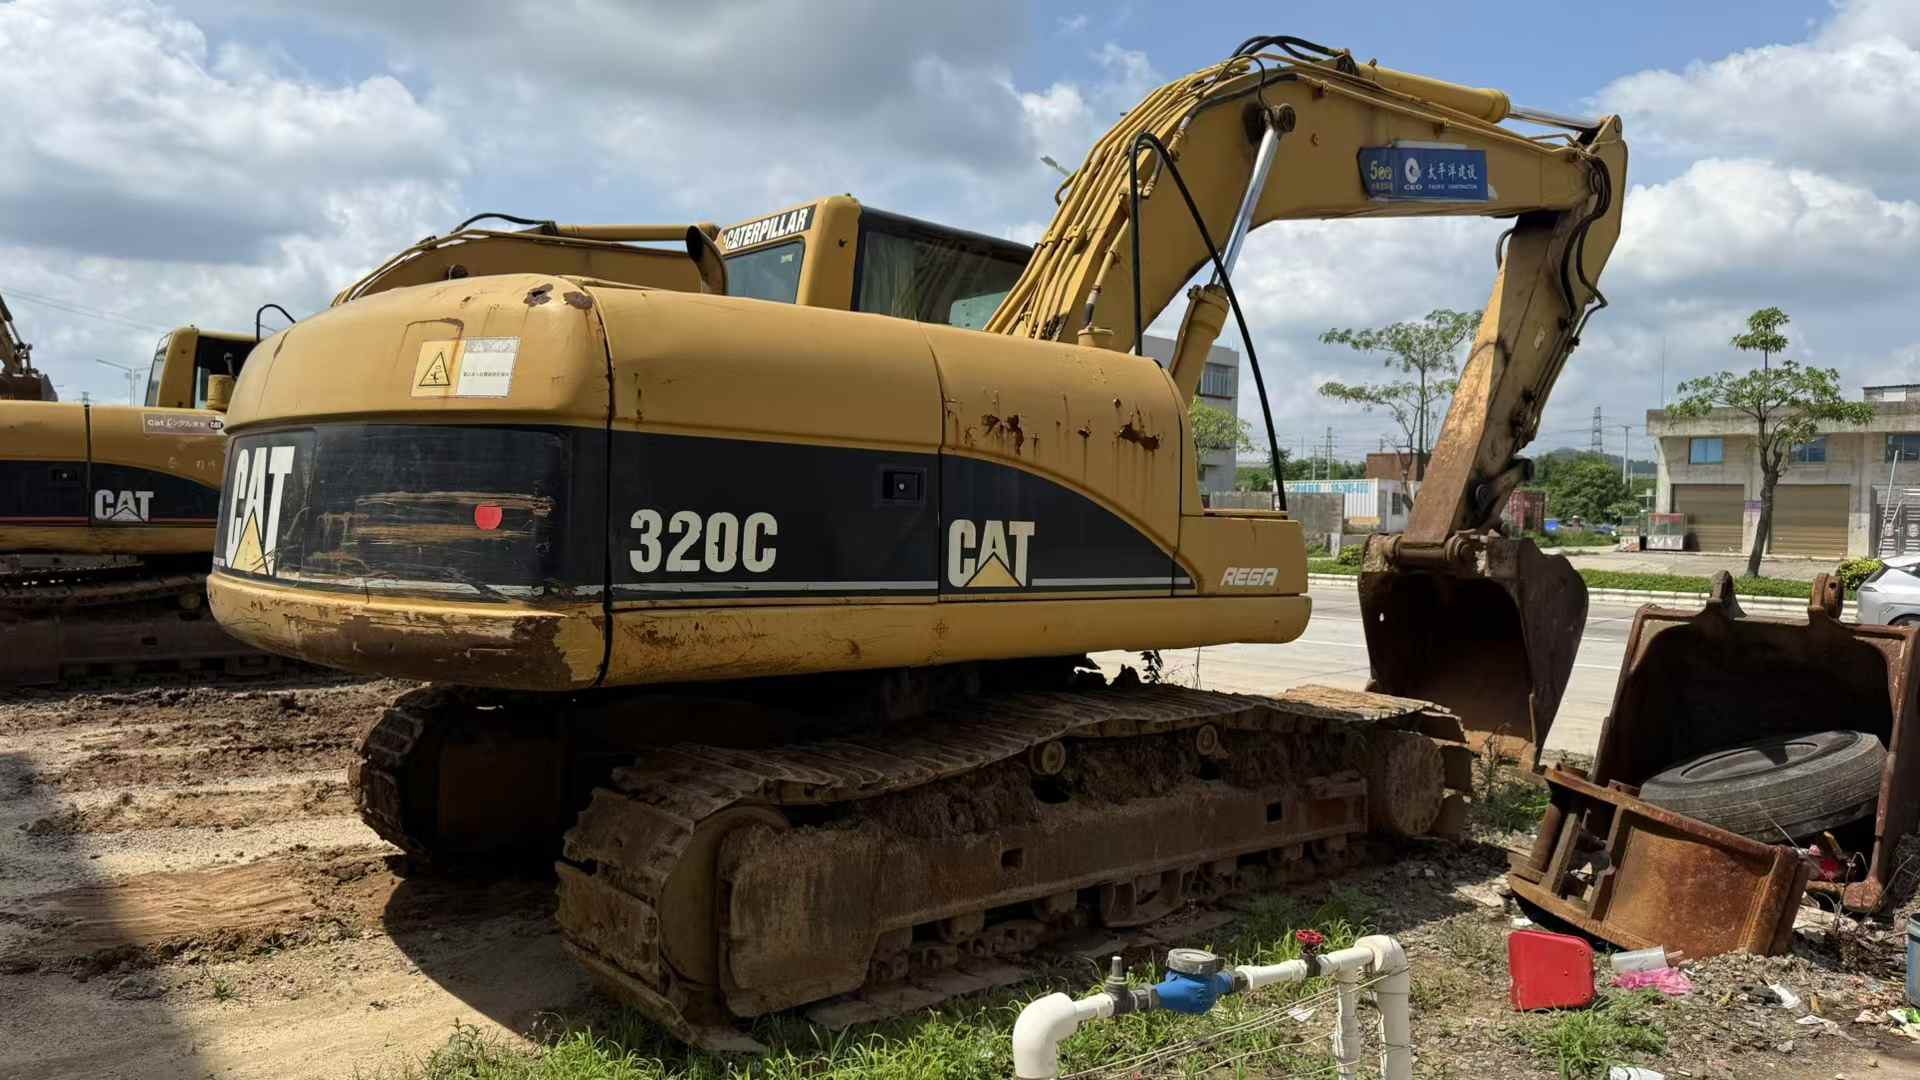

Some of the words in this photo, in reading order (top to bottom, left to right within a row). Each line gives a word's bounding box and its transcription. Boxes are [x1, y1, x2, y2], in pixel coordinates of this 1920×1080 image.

[725, 208, 808, 250] CATERPILLAR
[94, 489, 154, 522] CAT
[226, 446, 295, 577] CAT
[629, 508, 778, 573] 320C
[948, 519, 1035, 588] CAT
[1220, 567, 1279, 587] REGA
